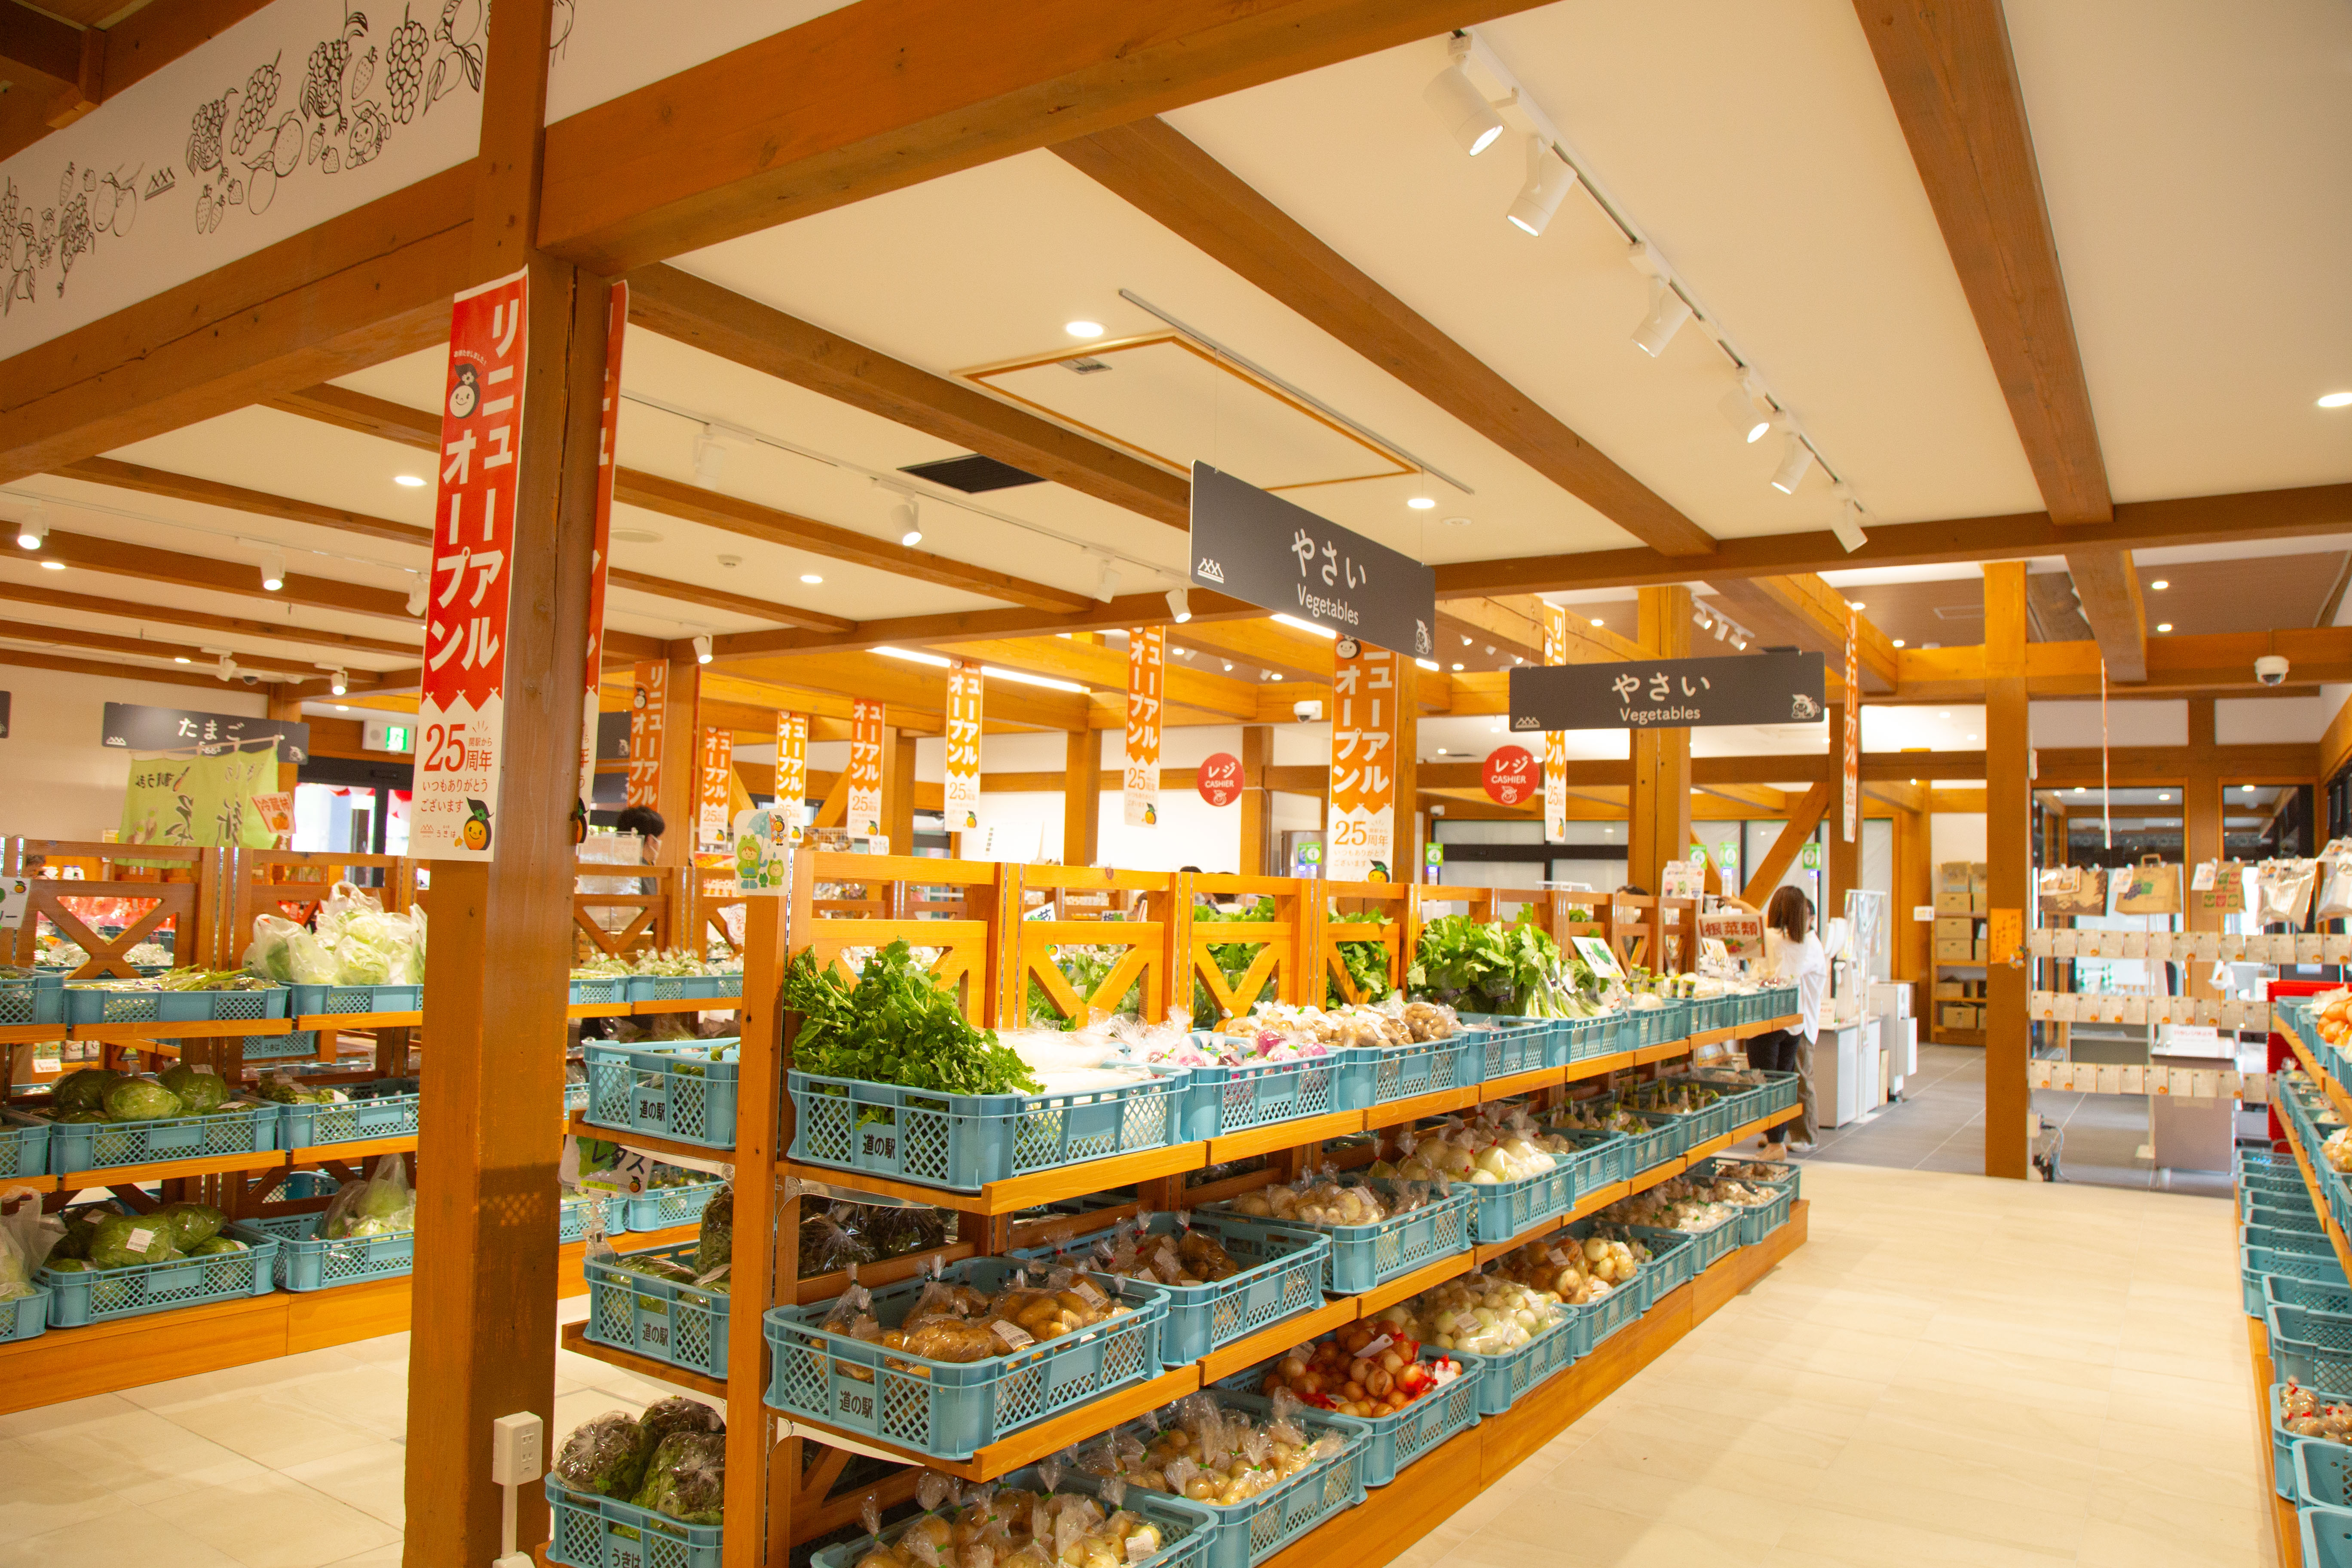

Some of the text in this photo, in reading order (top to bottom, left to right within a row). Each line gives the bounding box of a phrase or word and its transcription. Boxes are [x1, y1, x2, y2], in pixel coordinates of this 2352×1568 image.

[463, 298, 520, 673] リニューアル
[429, 429, 478, 671] オープン
[1292, 528, 1366, 589] やさい
[1297, 583, 1359, 625] Vegetables
[1128, 639, 1145, 744] オープン
[1612, 672, 1711, 704] やさい
[948, 674, 965, 763] オープン
[1620, 705, 1701, 725] Vegetables
[178, 717, 245, 741] たまご
[641, 666, 663, 805] リニューアル
[851, 702, 867, 779] オープン
[1333, 665, 1362, 793] オープン
[424, 723, 466, 772] 25
[629, 712, 646, 805] オープン
[778, 722, 791, 790] オープン
[465, 749, 493, 772] 周年
[704, 736, 718, 796] オープン
[1208, 762, 1236, 778] レジ
[1495, 755, 1528, 774] レジ
[423, 778, 488, 792] いつもありがとう
[1128, 767, 1145, 790] 25
[1204, 780, 1234, 788] CASHIER
[1491, 775, 1527, 784] CASHIER
[949, 782, 966, 800] 25
[1547, 784, 1559, 806] 25
[420, 799, 464, 813] ございます
[852, 795, 868, 812] 25
[704, 810, 717, 822] 25
[1335, 820, 1367, 846] 25
[1368, 835, 1388, 846] 周年
[640, 1099, 665, 1122] 道の駅
[862, 1134, 895, 1159] 道の駅
[642, 1323, 668, 1347] 道の駅
[839, 1390, 873, 1419] 道の駅
[612, 1547, 641, 1568] うきは
